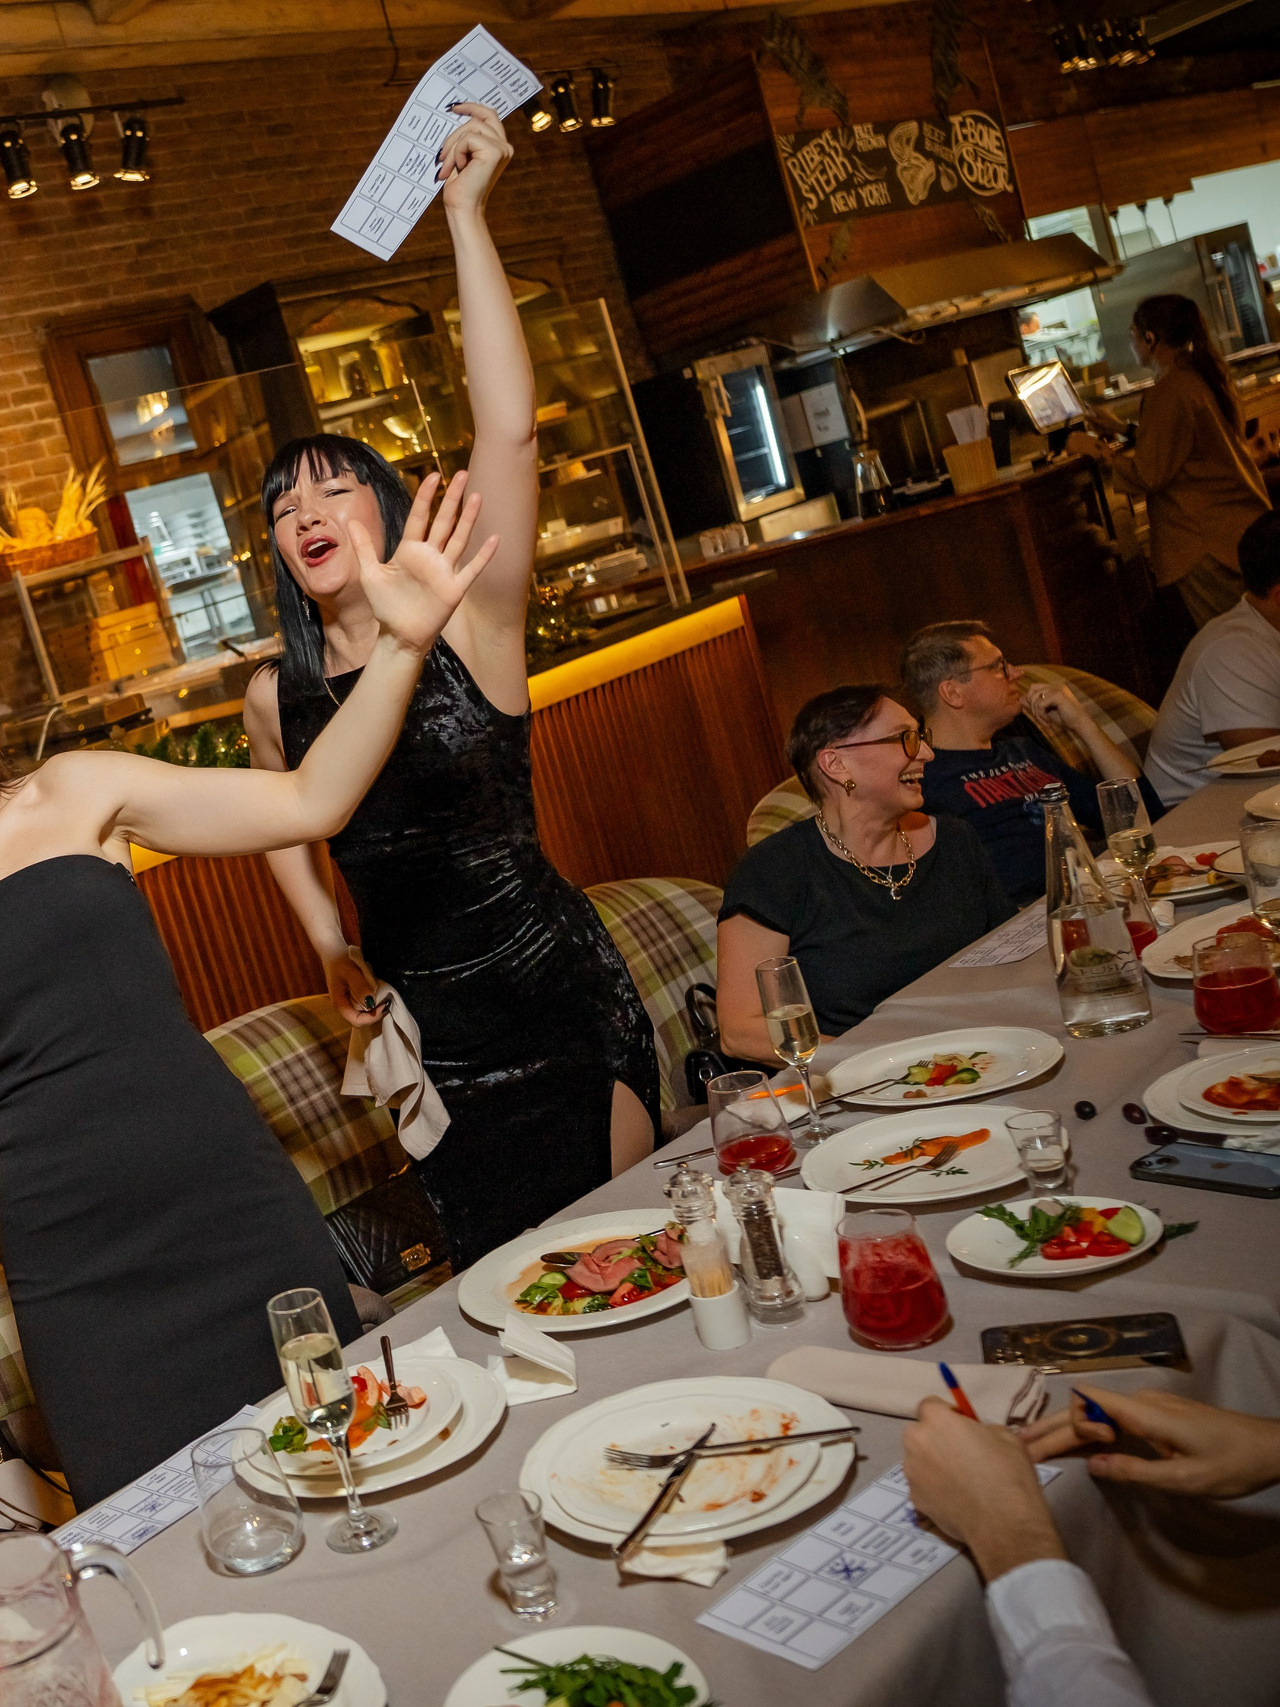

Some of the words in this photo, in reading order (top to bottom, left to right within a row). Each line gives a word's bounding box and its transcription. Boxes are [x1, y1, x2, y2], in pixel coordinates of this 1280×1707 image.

[948, 114, 1004, 158] T-BONE
[802, 140, 854, 210] STEAK
[829, 188, 858, 214] NEW
[857, 181, 892, 208] YORK
